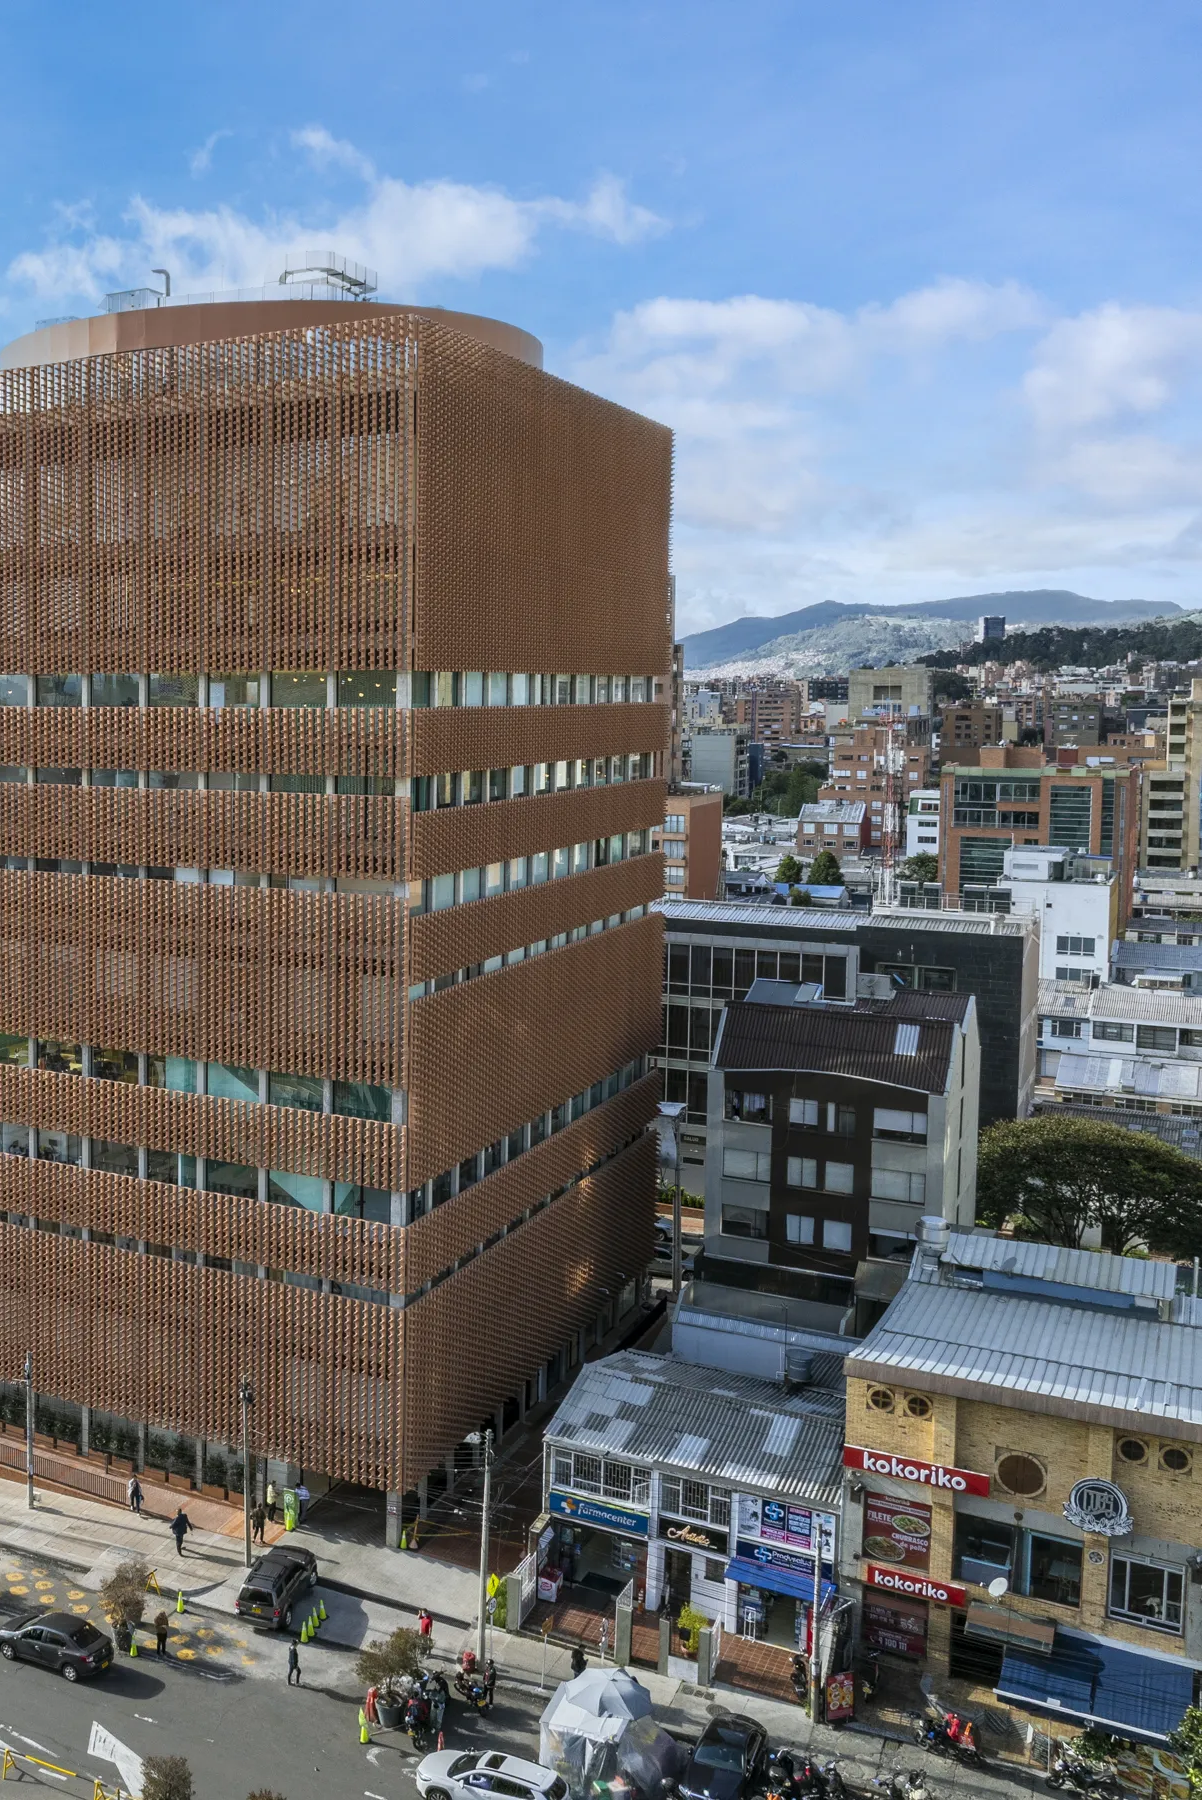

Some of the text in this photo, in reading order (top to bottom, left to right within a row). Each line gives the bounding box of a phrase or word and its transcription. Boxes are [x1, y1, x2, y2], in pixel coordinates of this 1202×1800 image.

[863, 1451, 967, 1491] kokoriko
[578, 1503, 636, 1527] farmacenter
[867, 1510, 892, 1522] FILETE
[892, 1532, 929, 1547] CHURRASCO
[899, 1541, 927, 1553] de pollo
[874, 1570, 948, 1600] kokoriko
[884, 1638, 897, 1648] 100
